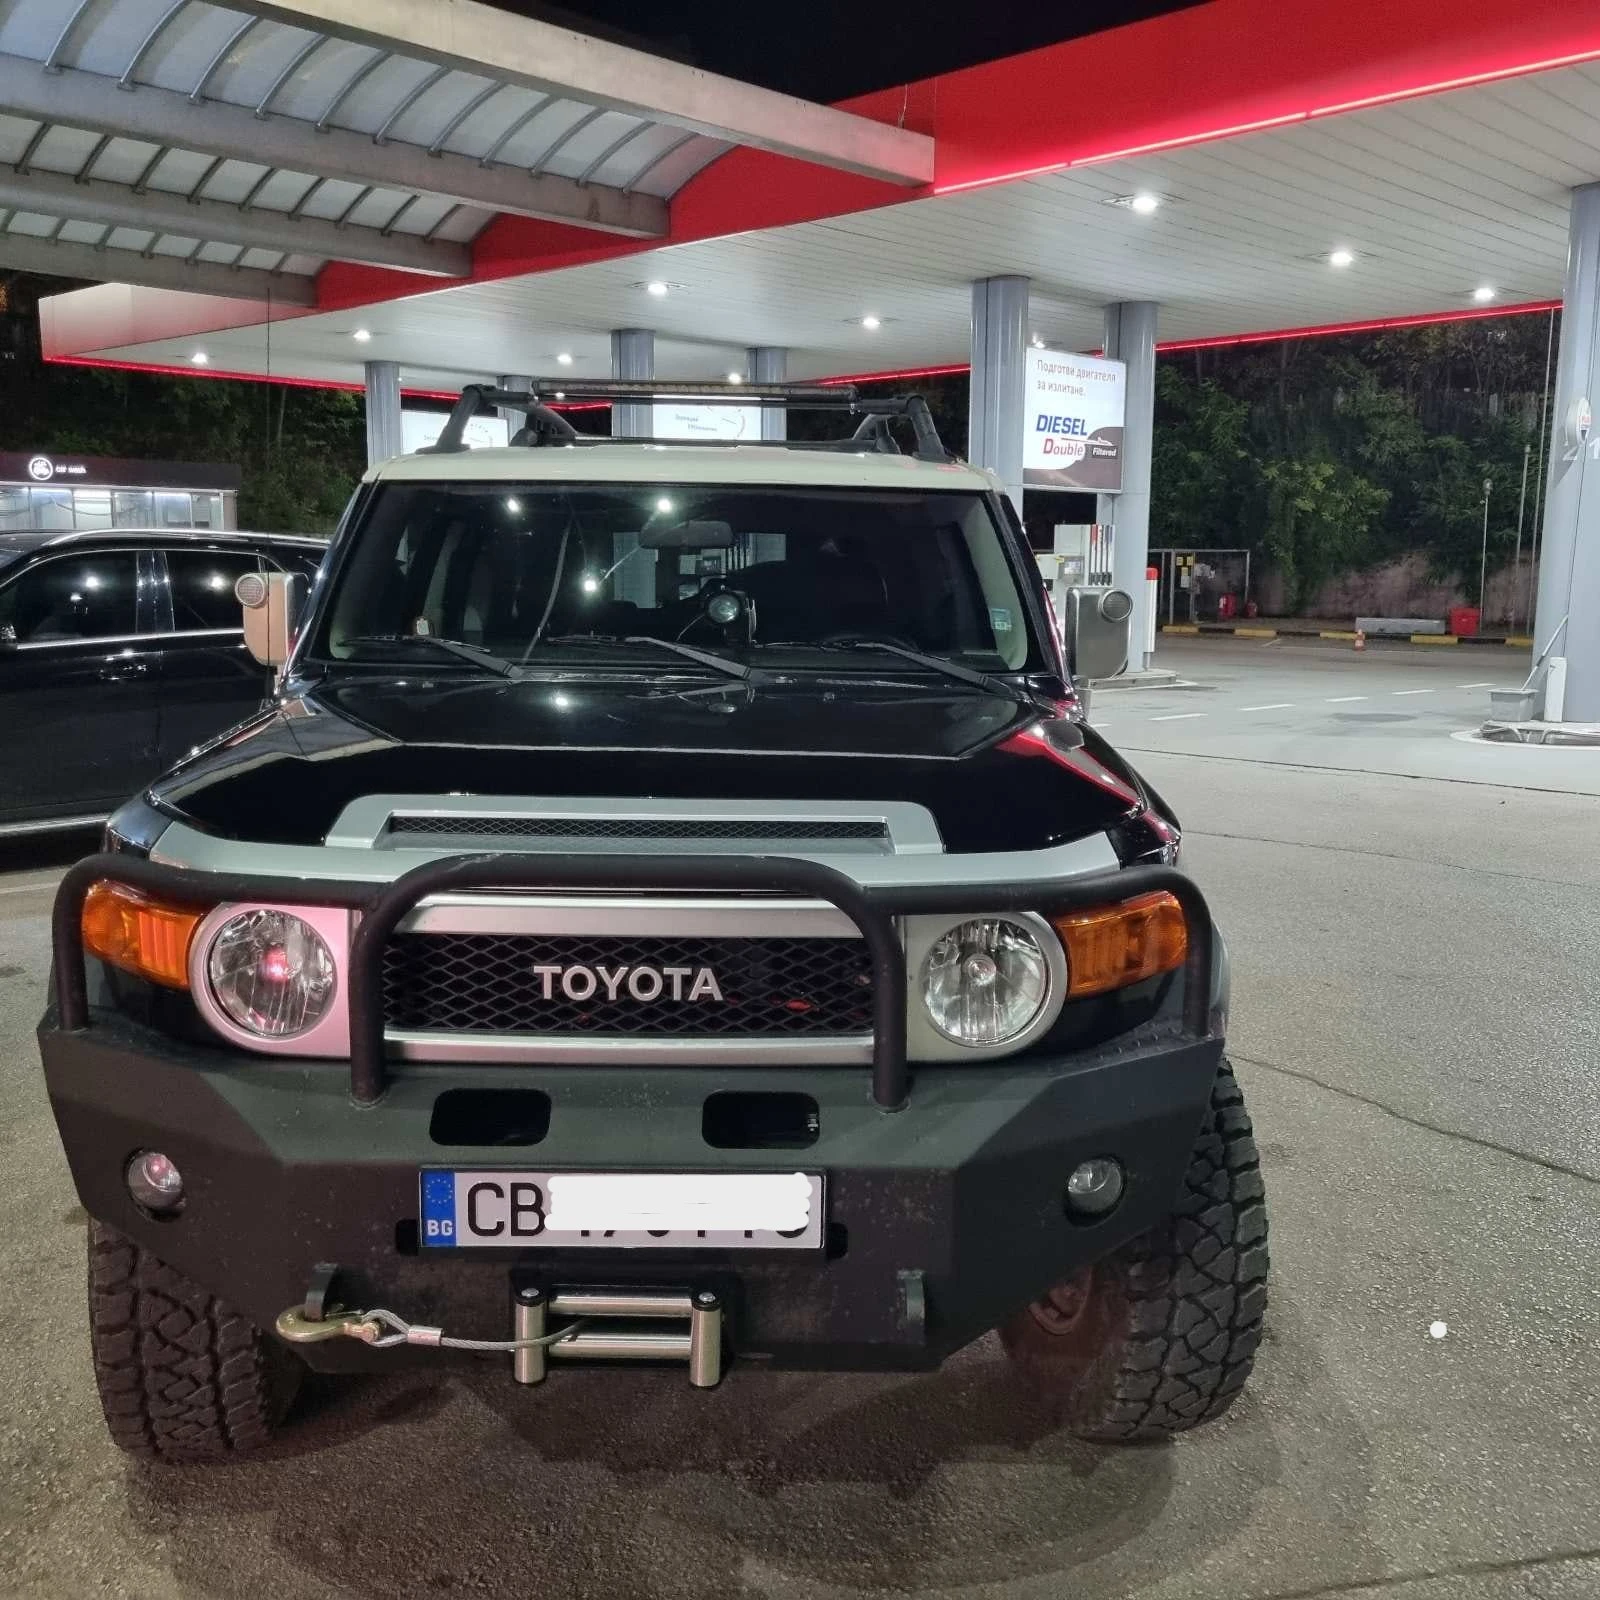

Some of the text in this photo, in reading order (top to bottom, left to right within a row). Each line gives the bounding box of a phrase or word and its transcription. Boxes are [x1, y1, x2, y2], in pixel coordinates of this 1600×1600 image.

[1038, 360, 1116, 384] Подготви двигателя
[1037, 380, 1046, 391] за
[1036, 414, 1088, 436] DIESEL
[1043, 438, 1084, 457] Double
[533, 965, 724, 1001] TOYOTA
[427, 1219, 453, 1236] BG
